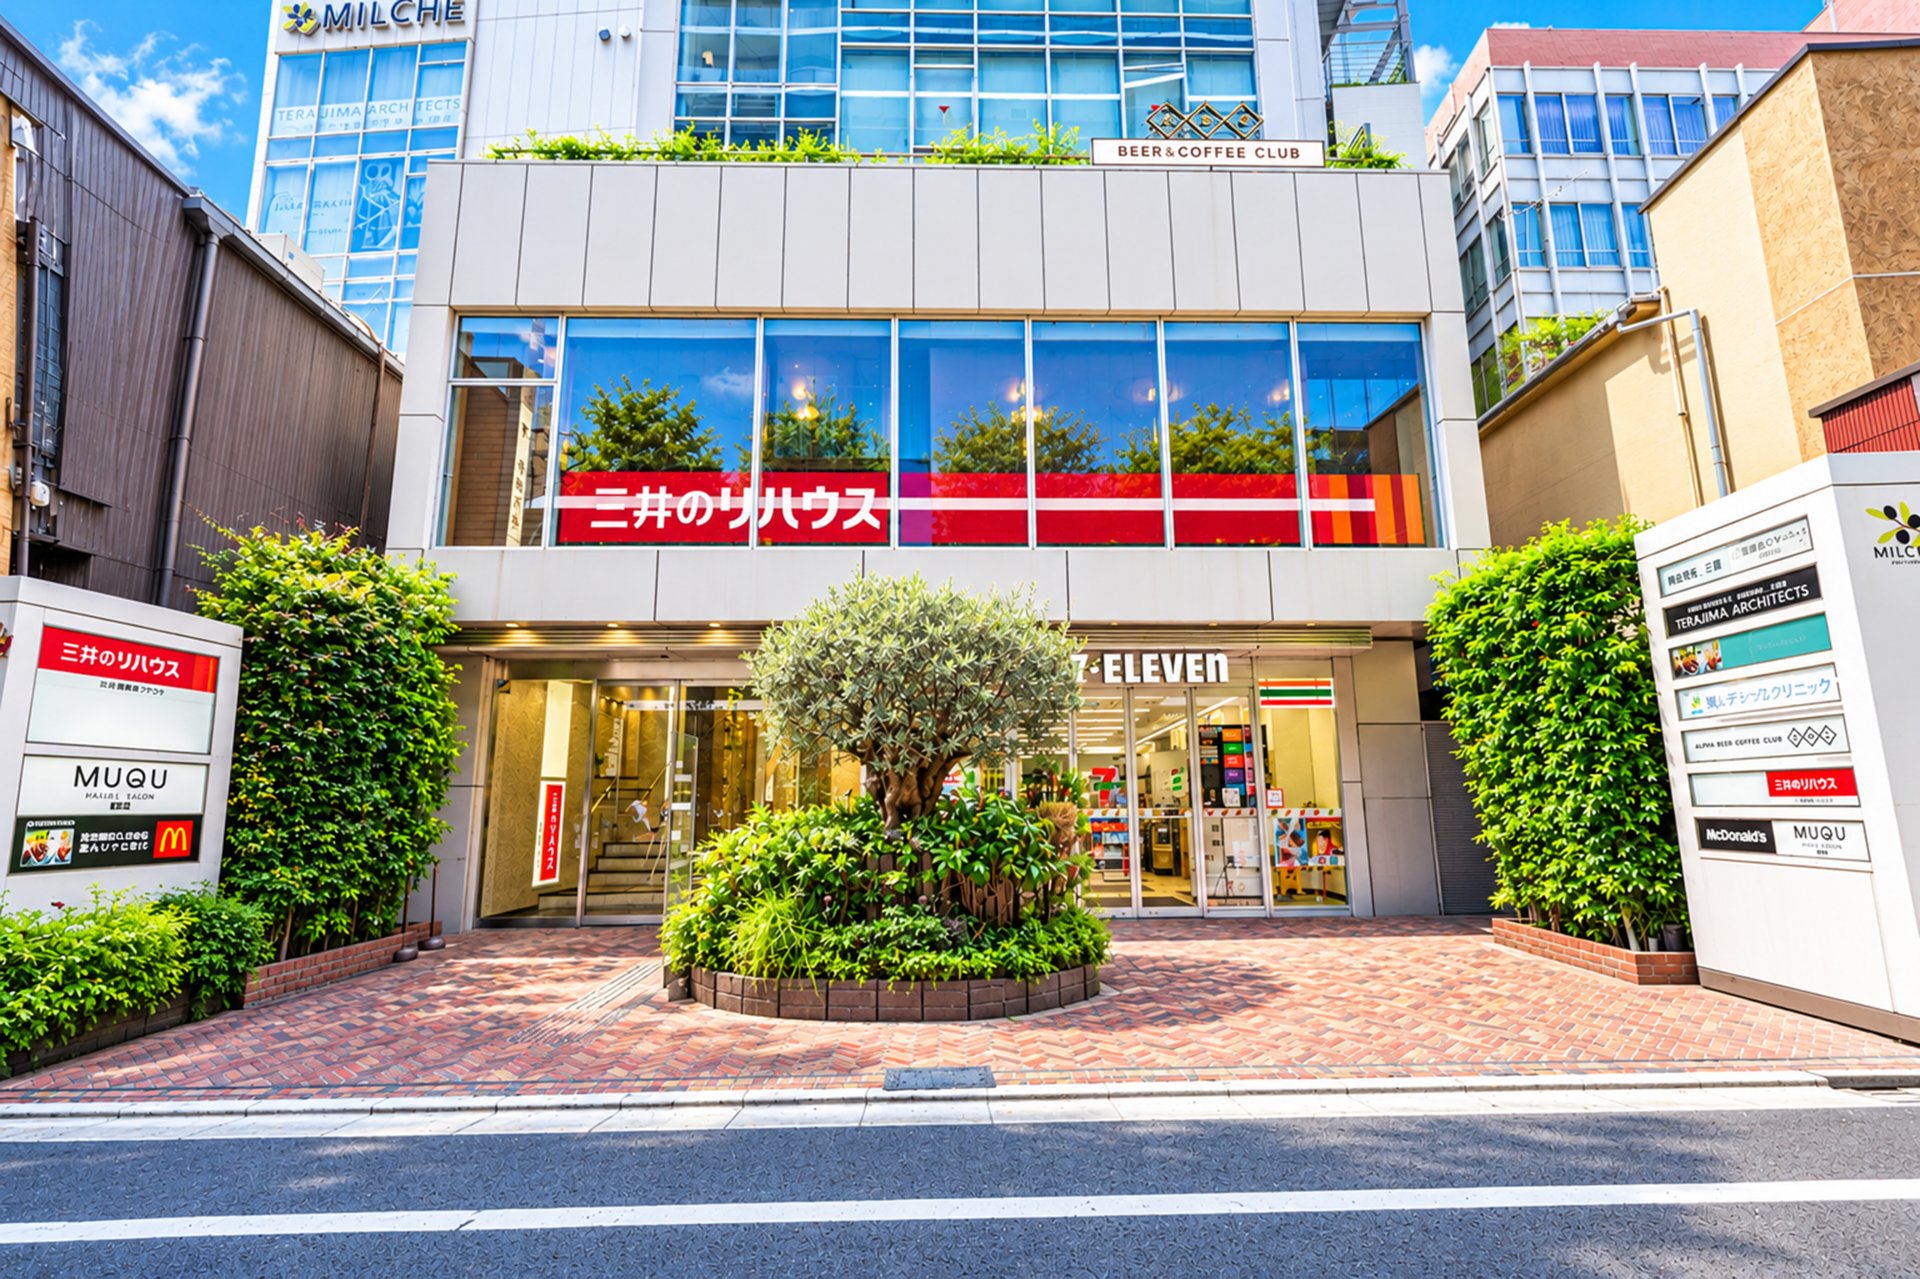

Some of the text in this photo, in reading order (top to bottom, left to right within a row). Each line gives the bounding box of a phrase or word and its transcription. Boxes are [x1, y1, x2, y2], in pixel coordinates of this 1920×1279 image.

[323, 0, 463, 28] MILCHE
[367, 98, 460, 114] ARCHTECTS
[1255, 147, 1300, 159] CLUB
[590, 485, 881, 530] 三井のリハウス
[1675, 607, 1729, 630] TERAJIMA
[1732, 584, 1810, 616] ARCHITECTS
[60, 642, 180, 678] 三井のリハウス
[74, 765, 167, 788] MUQU
[1775, 778, 1838, 790] 三井のリハウス
[1706, 825, 1846, 843] McDonald's MUQU
